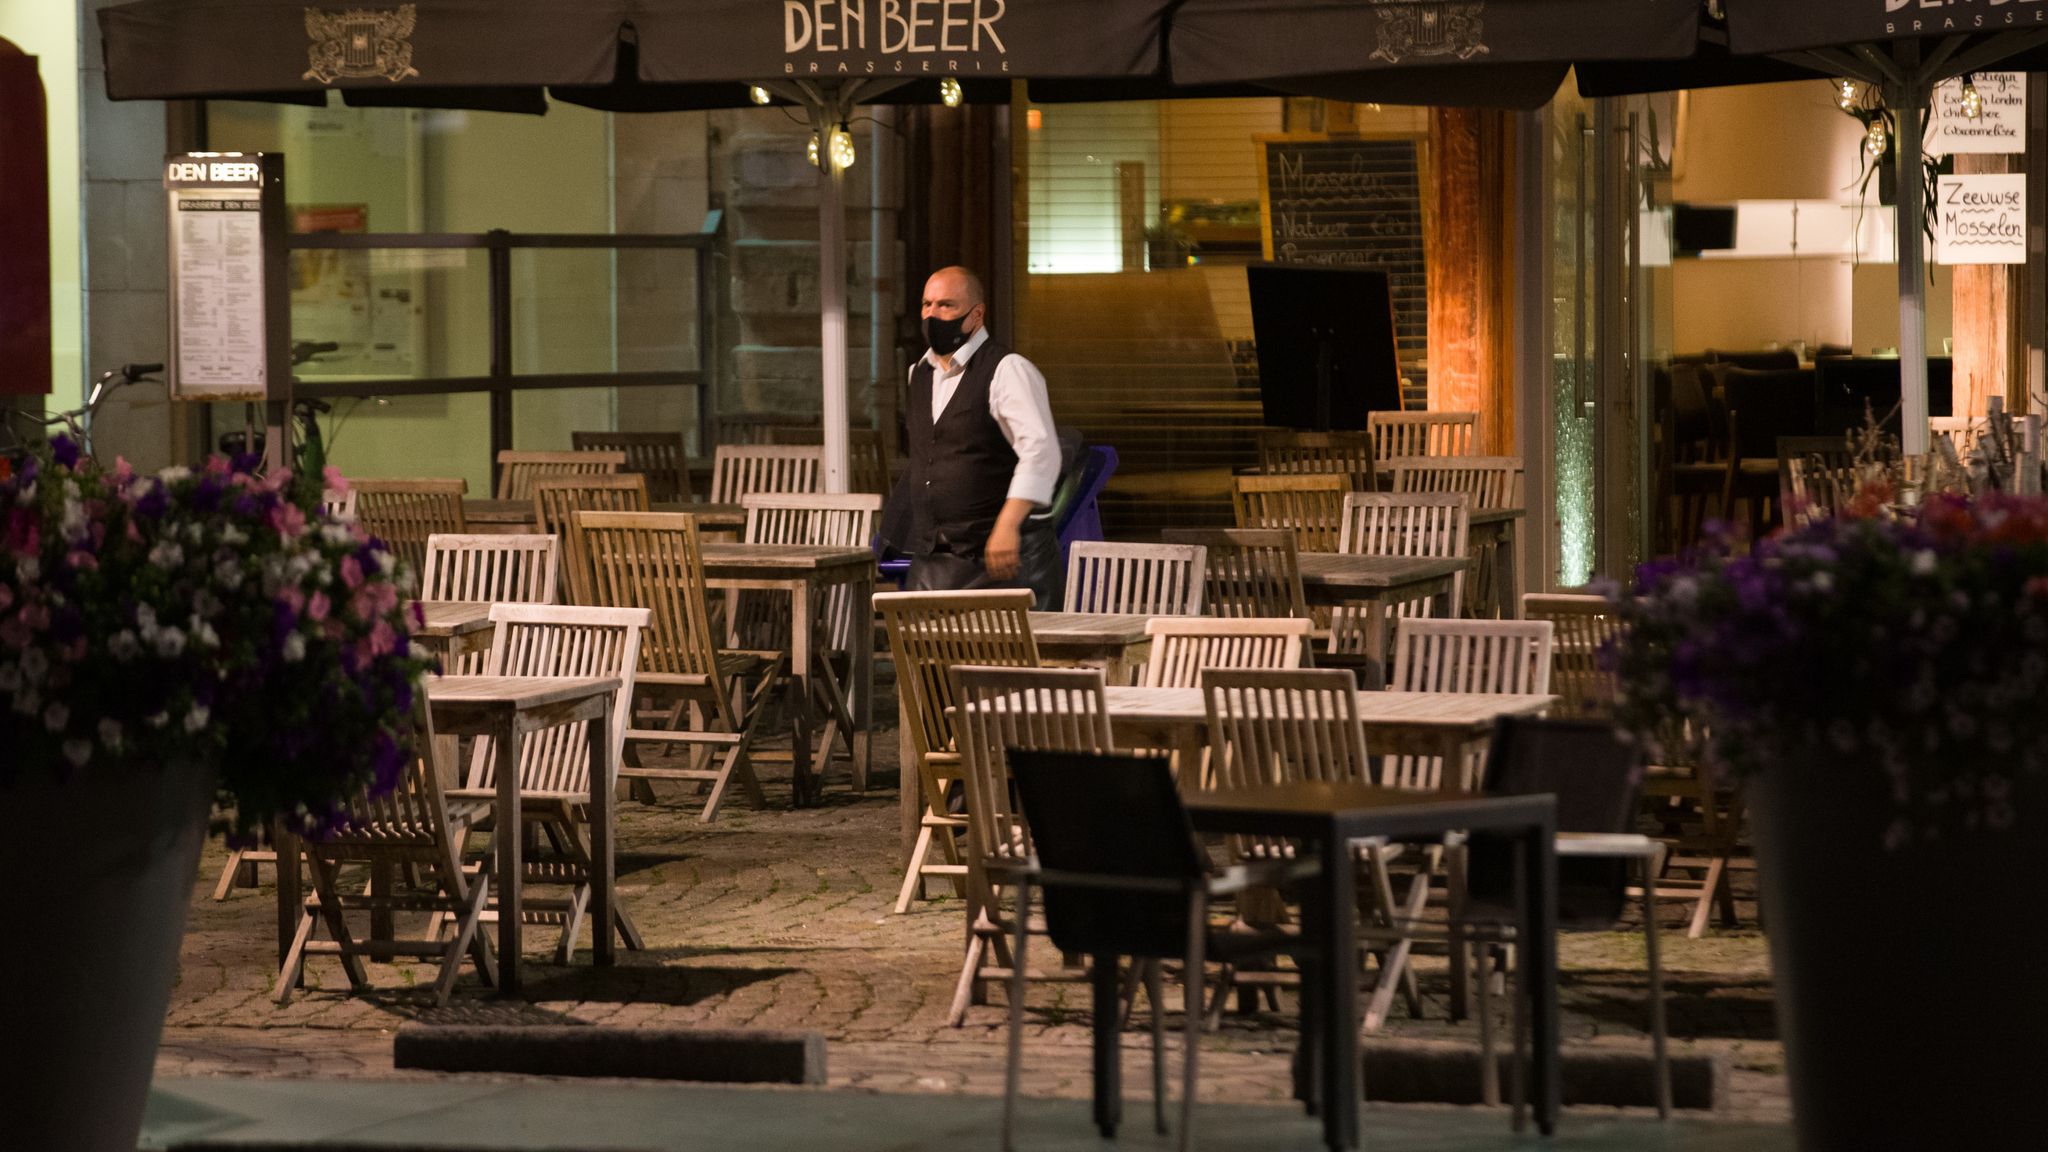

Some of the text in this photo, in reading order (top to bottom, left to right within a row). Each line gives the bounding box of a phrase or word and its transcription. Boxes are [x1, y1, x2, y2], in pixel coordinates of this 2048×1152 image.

[784, 0, 1006, 54] DEN BEER
[785, 60, 1009, 73] BRASSERIE
[169, 163, 259, 181] DEN BEER
[1943, 183, 2020, 205] Zeeuwse
[1945, 212, 2023, 237] Mosselen
